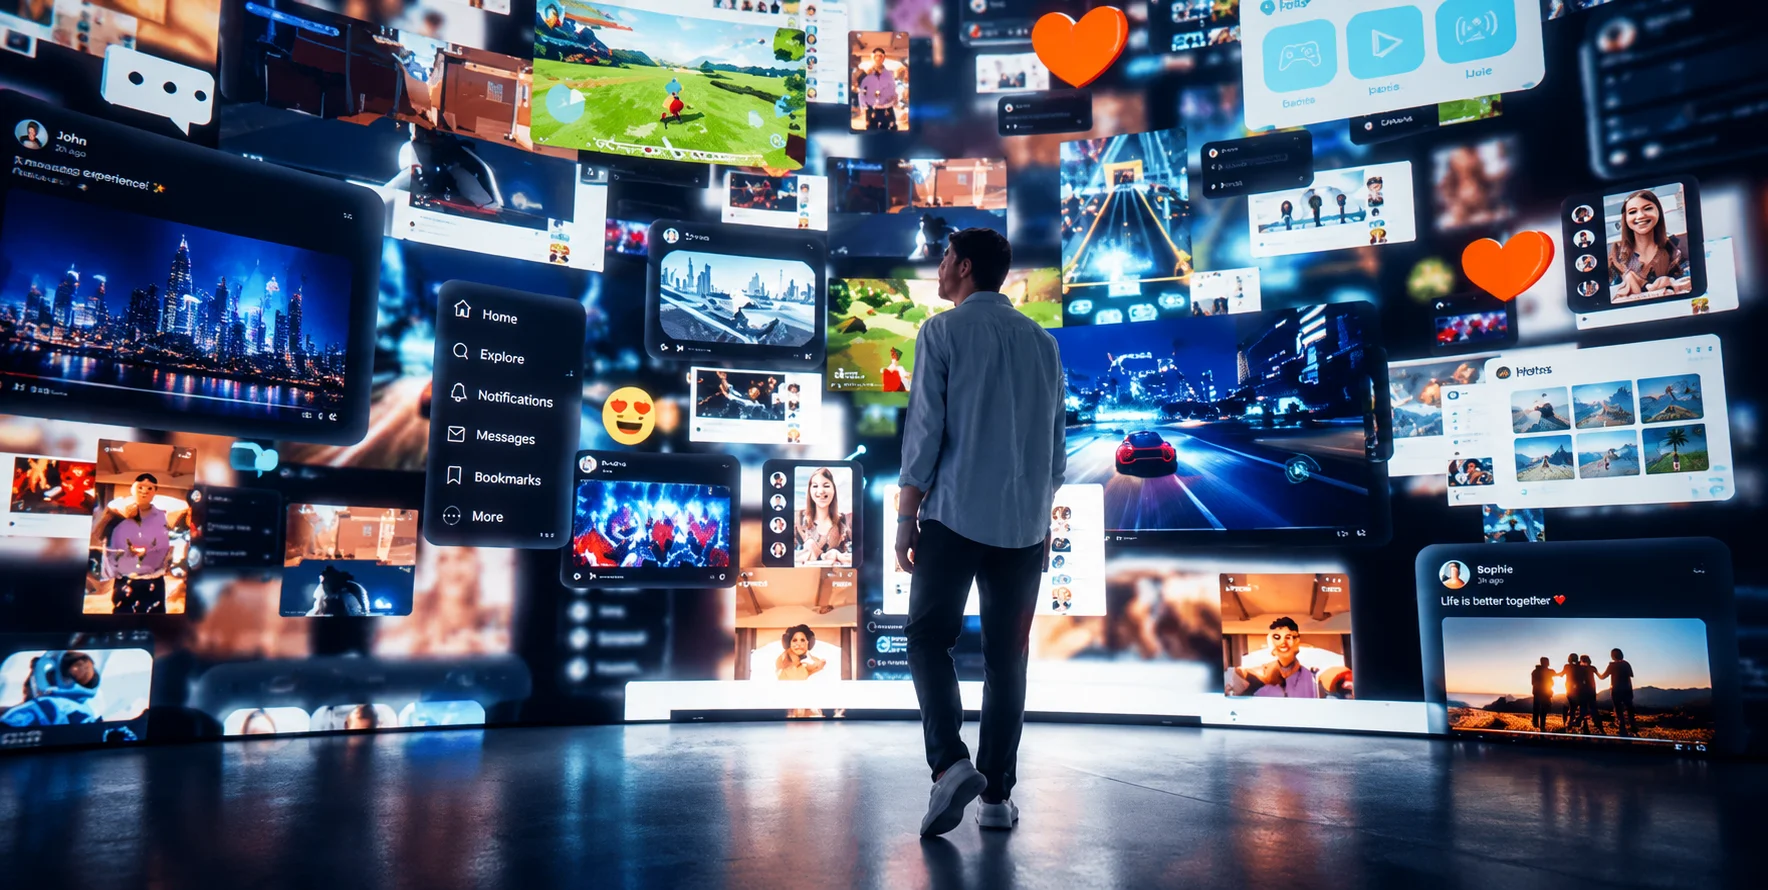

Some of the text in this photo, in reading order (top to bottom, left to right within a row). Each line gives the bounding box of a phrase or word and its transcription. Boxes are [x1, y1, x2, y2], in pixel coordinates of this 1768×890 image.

[56, 131, 87, 147] John
[68, 149, 87, 158] ago
[482, 309, 518, 324] Home
[480, 348, 525, 365] Explore
[478, 389, 554, 408] Notifications
[476, 429, 536, 447] Messages
[474, 471, 542, 487] Bookmarks
[472, 510, 504, 522] More
[1477, 564, 1514, 576] Sophie
[1488, 578, 1505, 586] ago
[1440, 596, 1551, 608] Life is better together
